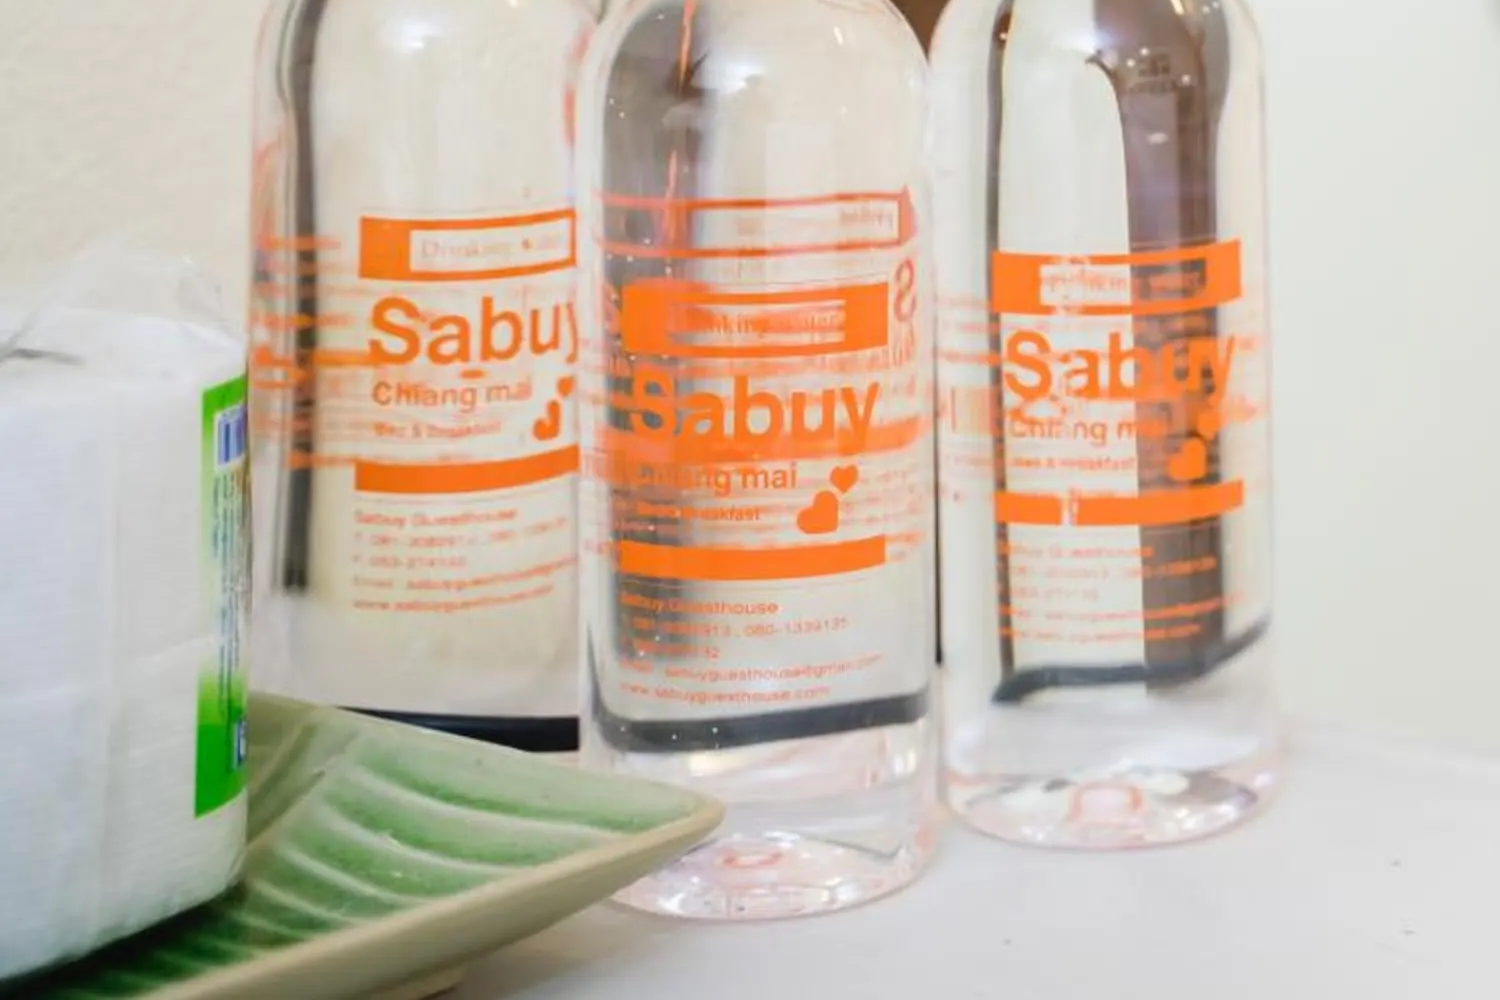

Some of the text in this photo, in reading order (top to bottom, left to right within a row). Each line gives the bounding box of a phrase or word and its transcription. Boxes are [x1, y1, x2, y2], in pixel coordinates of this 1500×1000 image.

[1004, 329, 1236, 410] Sabuy
[630, 370, 880, 455] Sabuy
[741, 461, 798, 489] mai
